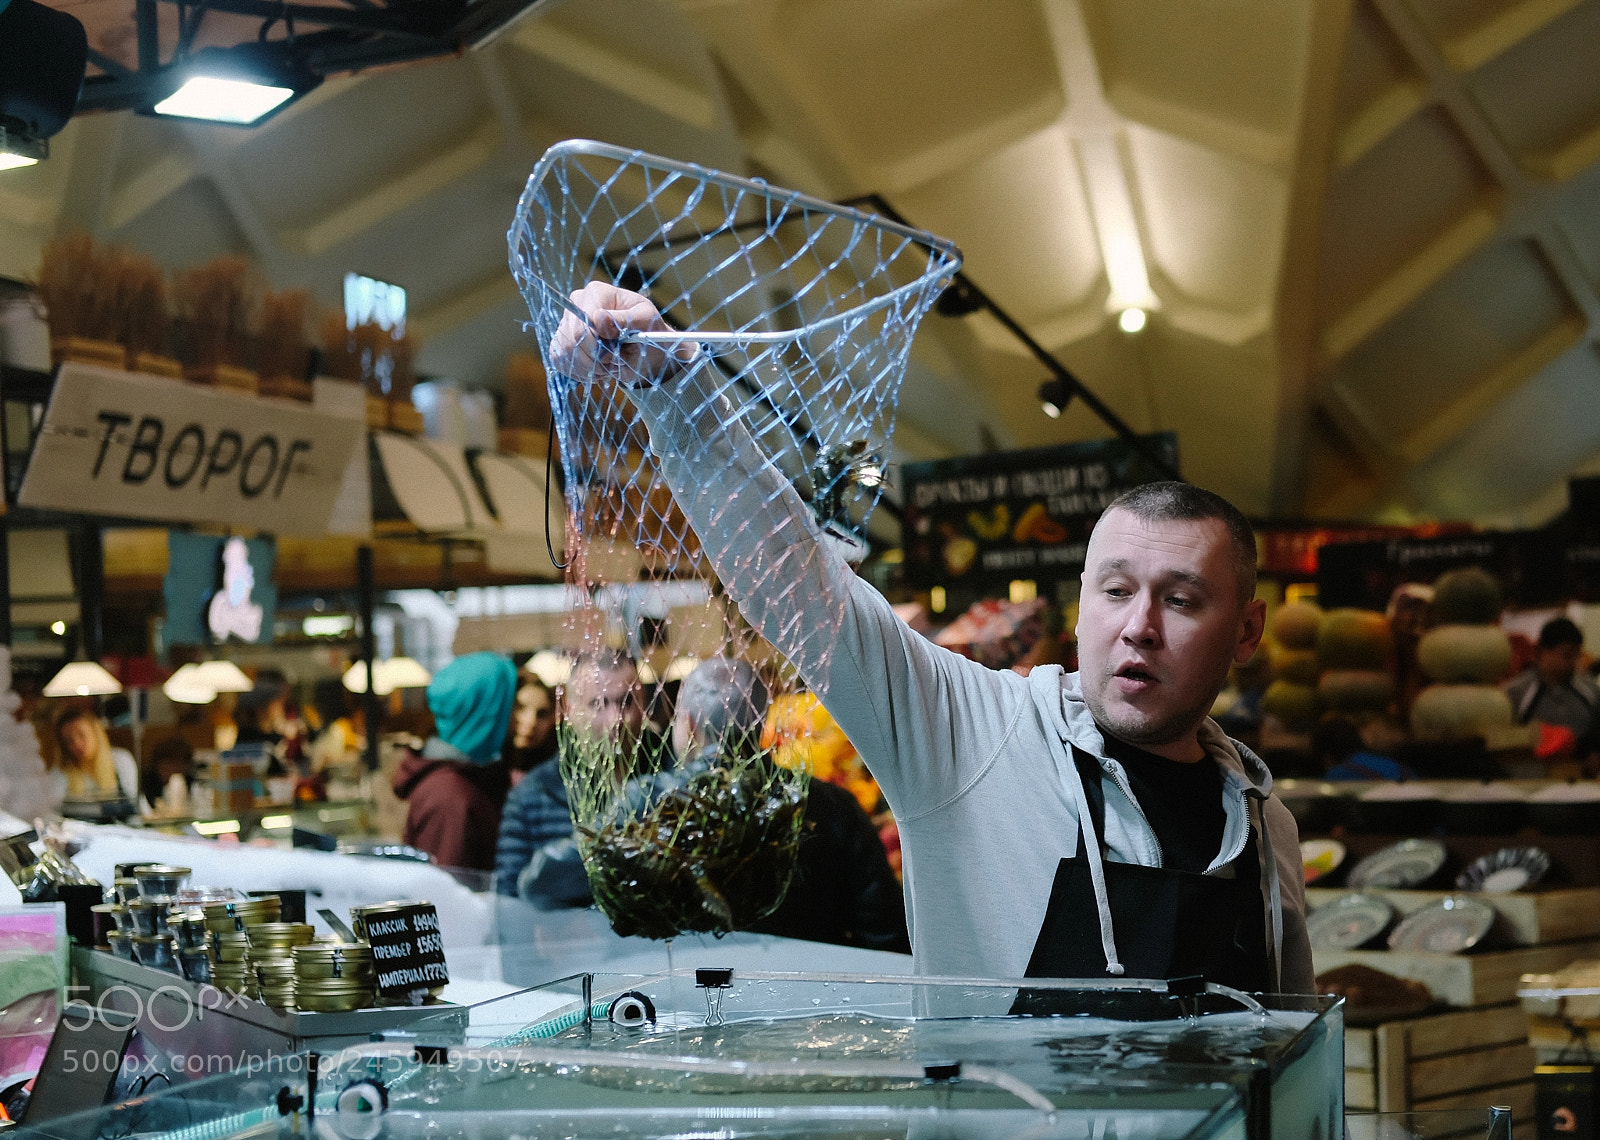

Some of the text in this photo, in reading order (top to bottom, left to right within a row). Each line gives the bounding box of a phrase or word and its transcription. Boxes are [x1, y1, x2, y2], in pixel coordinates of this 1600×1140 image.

[92, 411, 312, 498] ТВОРОГ
[368, 918, 408, 937] КЛАССИК
[373, 942, 411, 960] ПРЕМЬЕР
[378, 968, 425, 988] ИМПЕРИАЛ
